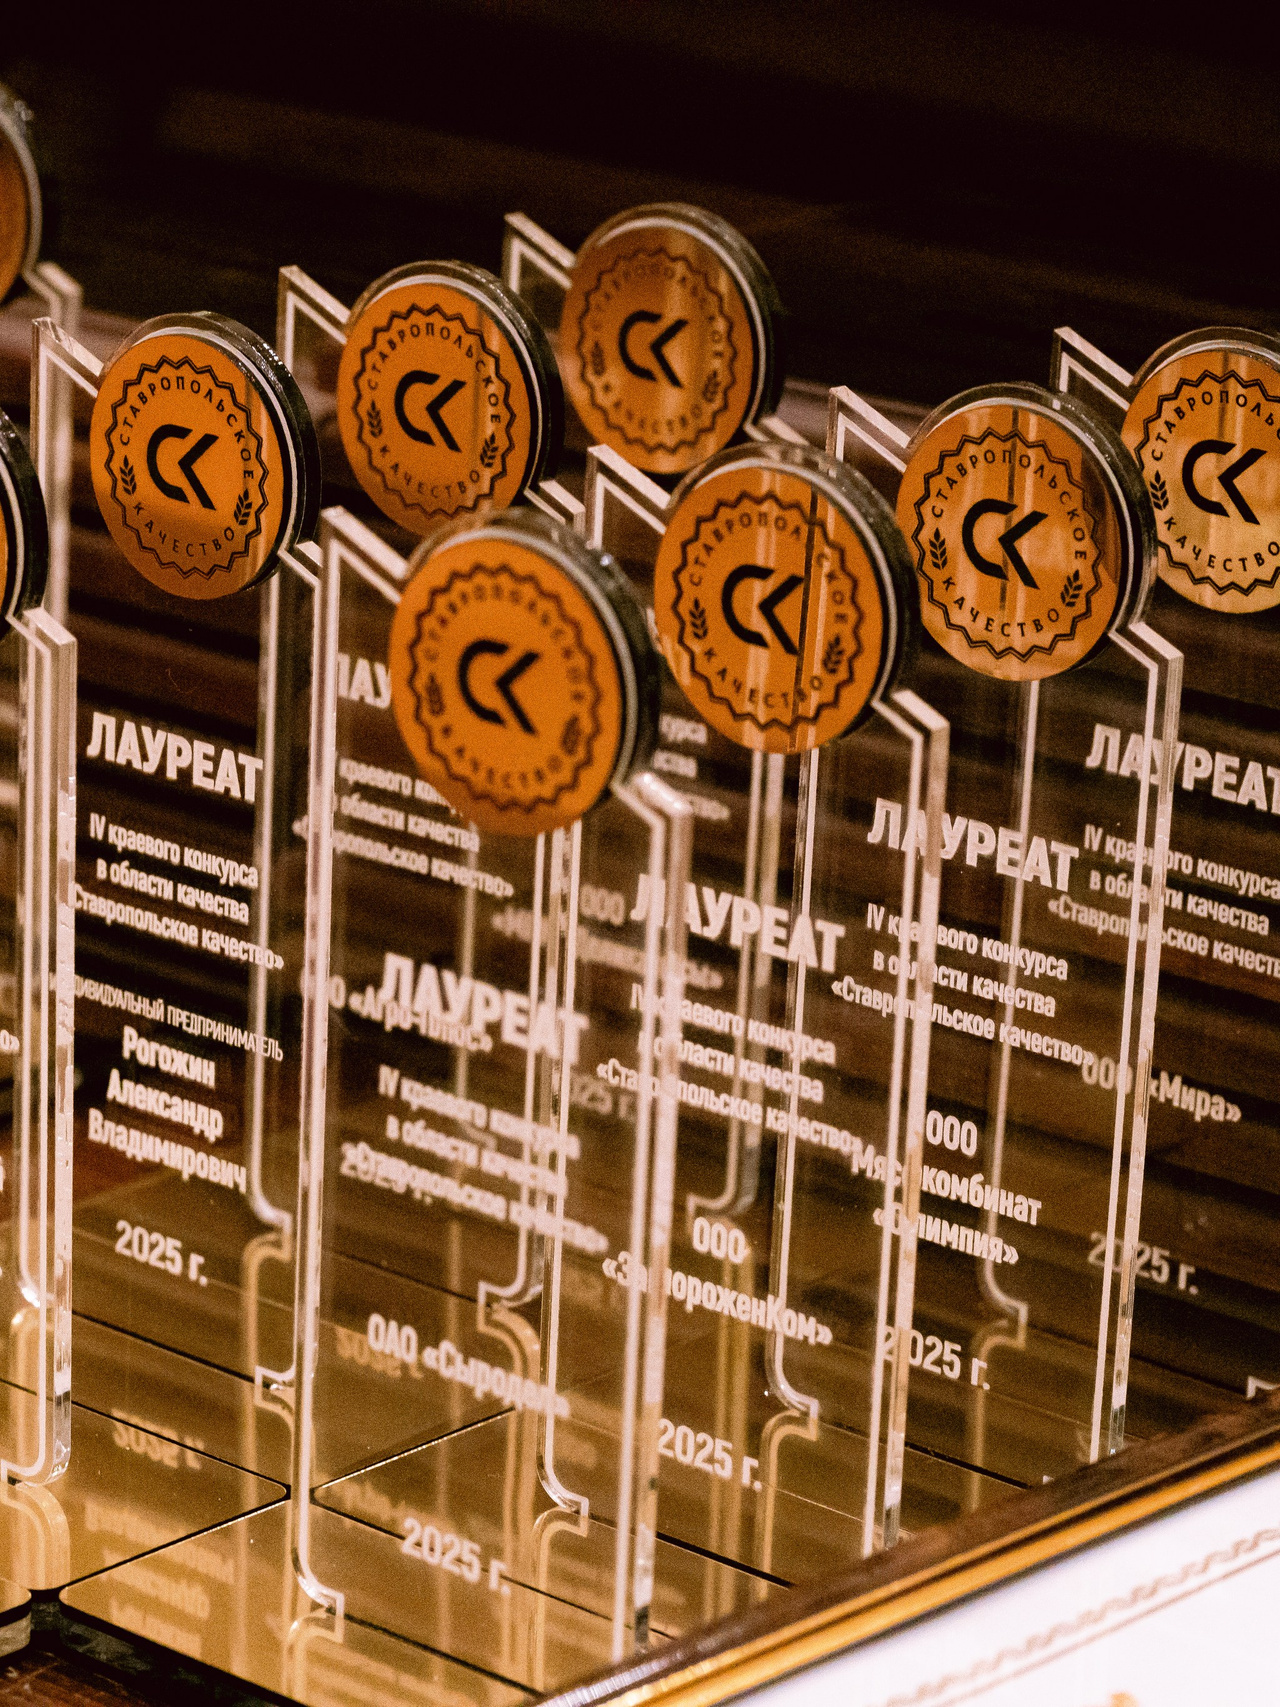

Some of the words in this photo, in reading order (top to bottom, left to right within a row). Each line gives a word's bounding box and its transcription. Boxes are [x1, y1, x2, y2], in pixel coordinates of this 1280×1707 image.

[367, 321, 502, 424] СТАВРОПОЛЬСКОЕ
[118, 375, 254, 480] СТАВРОПОЛЬСКОЕ
[377, 444, 481, 498] КАЧЕСТВО
[132, 503, 235, 557] КАЧЕСТВО
[931, 449, 1088, 562] СТАВРОПОЛЬСКОЕ
[1163, 516, 1280, 573] КАЧЕСТВО
[941, 576, 1060, 638] КАЧЕСТВО
[86, 711, 264, 804] ЛАУРЕАТ
[88, 812, 106, 842] IV
[108, 823, 181, 867] краевого
[184, 846, 259, 889] конкурса
[866, 796, 1080, 893] ЛАУРЕАТ
[1083, 824, 1103, 851] IV
[1196, 858, 1280, 900] конкурса
[96, 857, 108, 881] в
[109, 860, 174, 901] области
[177, 882, 250, 926] качества
[1089, 870, 1101, 891] в
[1186, 892, 1270, 936] качества
[201, 927, 285, 970] качество»
[866, 902, 885, 932] IV
[981, 936, 1069, 981] конкурса
[382, 951, 589, 1066] ЛАУРЕАТ
[872, 949, 885, 972] в
[972, 974, 1056, 1018] качества
[122, 1025, 216, 1089] Рогожин
[166, 1005, 284, 1062] ПРЕДПРИНИМАТЕЛЬ
[747, 1018, 836, 1065] конкурса
[999, 1021, 1097, 1067] качество»
[106, 1068, 223, 1143] Александр
[738, 1055, 824, 1104] качества
[88, 1107, 247, 1194] Владимирович
[925, 1109, 978, 1159] ООО
[851, 1143, 1043, 1226] Мяскомбинат
[114, 1219, 183, 1277] 2025
[189, 1250, 208, 1287] г.
[692, 1216, 750, 1264] ООО
[1177, 1262, 1199, 1296] г.
[367, 1312, 419, 1365] ОАО
[970, 1357, 991, 1391] г.
[658, 1417, 733, 1480] 2025
[741, 1455, 763, 1493] г.
[401, 1517, 482, 1585] 2025
[488, 1558, 512, 1596] г.
